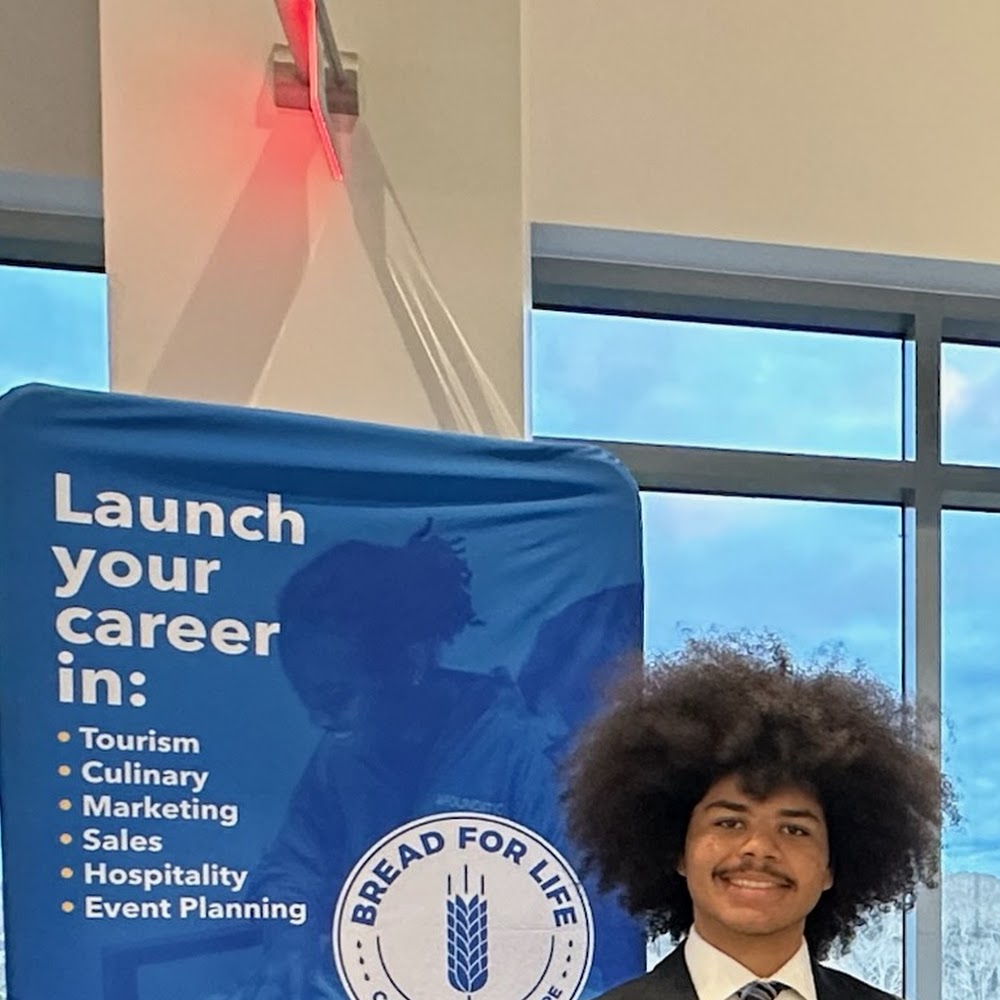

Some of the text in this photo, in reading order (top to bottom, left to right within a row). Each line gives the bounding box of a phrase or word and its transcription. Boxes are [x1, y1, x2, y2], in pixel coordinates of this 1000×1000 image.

[53, 471, 307, 547] Launch
[51, 544, 221, 598] your
[54, 606, 281, 657] career
[57, 651, 148, 708] in:
[79, 726, 201, 755] Tourism
[80, 761, 209, 794] Culinary
[82, 795, 240, 827] Marketing
[82, 829, 164, 853] Sales
[83, 862, 249, 892] Hospitality
[351, 826, 578, 927] BREAD FOR LIFE
[84, 897, 308, 925] Event Planning
